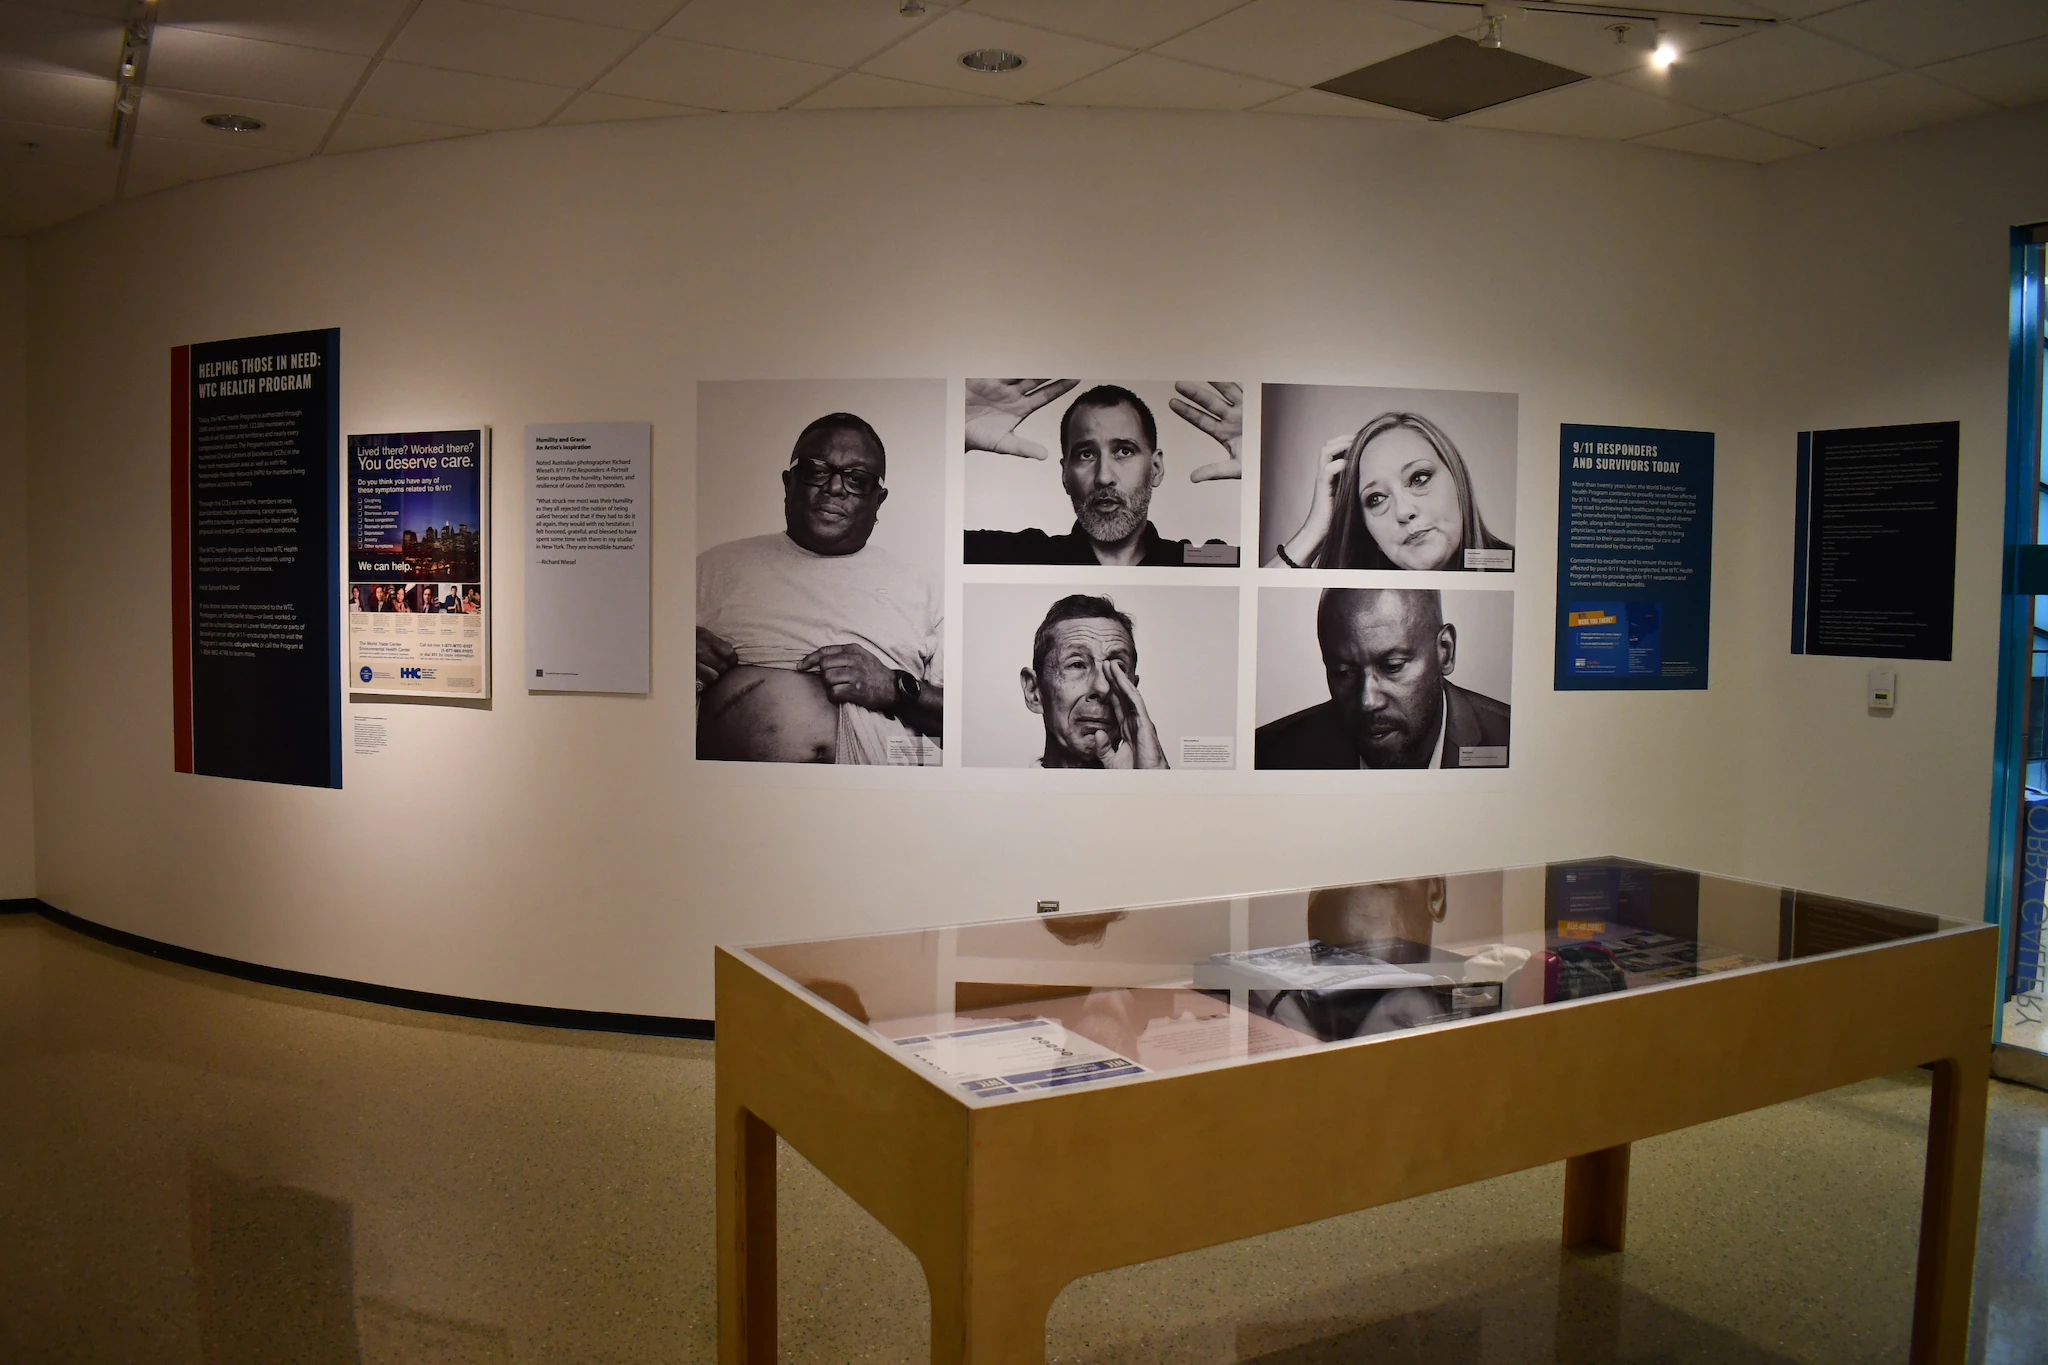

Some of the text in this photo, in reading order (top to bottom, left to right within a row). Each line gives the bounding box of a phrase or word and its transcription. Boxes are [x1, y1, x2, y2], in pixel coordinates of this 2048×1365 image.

[199, 352, 321, 378] HELPING THOSE IN NEED:
[199, 374, 311, 398] WTC HEALTH PROGRAM
[358, 443, 474, 456] Lived there? Worked there?
[1573, 442, 1657, 457] 9/11 RESPONDERS
[358, 456, 473, 470] You deserve care.
[1573, 457, 1680, 473] AND SURVIVORS TODAY
[358, 562, 372, 570] We
[392, 562, 412, 572] help.
